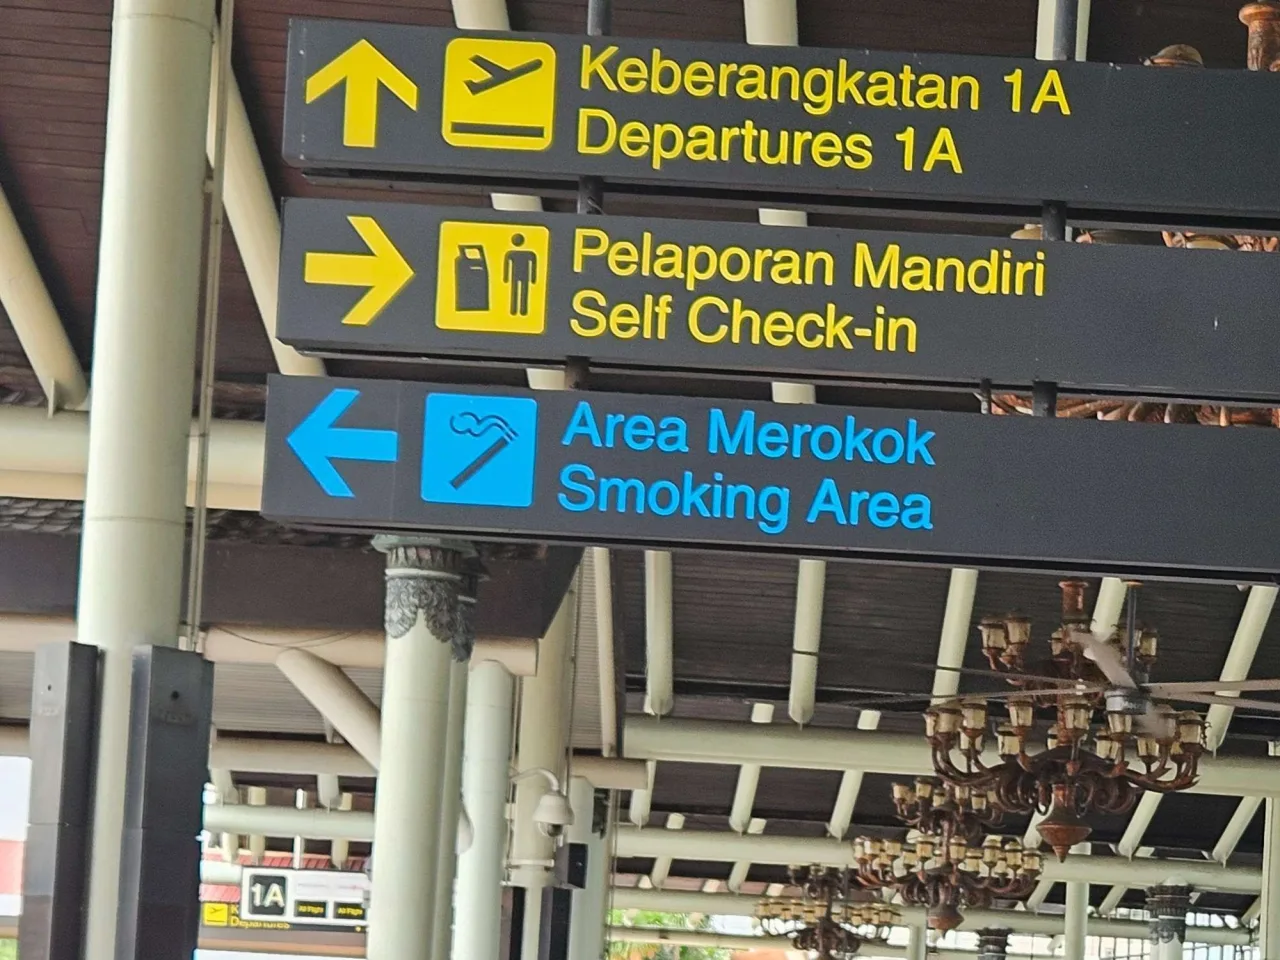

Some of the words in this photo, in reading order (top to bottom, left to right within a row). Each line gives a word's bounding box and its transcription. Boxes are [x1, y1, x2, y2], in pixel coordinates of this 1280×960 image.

[581, 45, 979, 116] Keberangkatan
[1004, 68, 1071, 115] 1A
[577, 108, 872, 169] Departures
[895, 126, 962, 173] 1A
[573, 228, 834, 289] Pelaporan
[854, 242, 1044, 295] Mandiri
[570, 289, 672, 341] Self
[688, 296, 917, 352] Check-in
[562, 403, 688, 452] Area
[708, 410, 934, 464] Merokok
[559, 464, 790, 534] Smoking
[807, 479, 932, 530] Area
[251, 883, 285, 907] 1A
